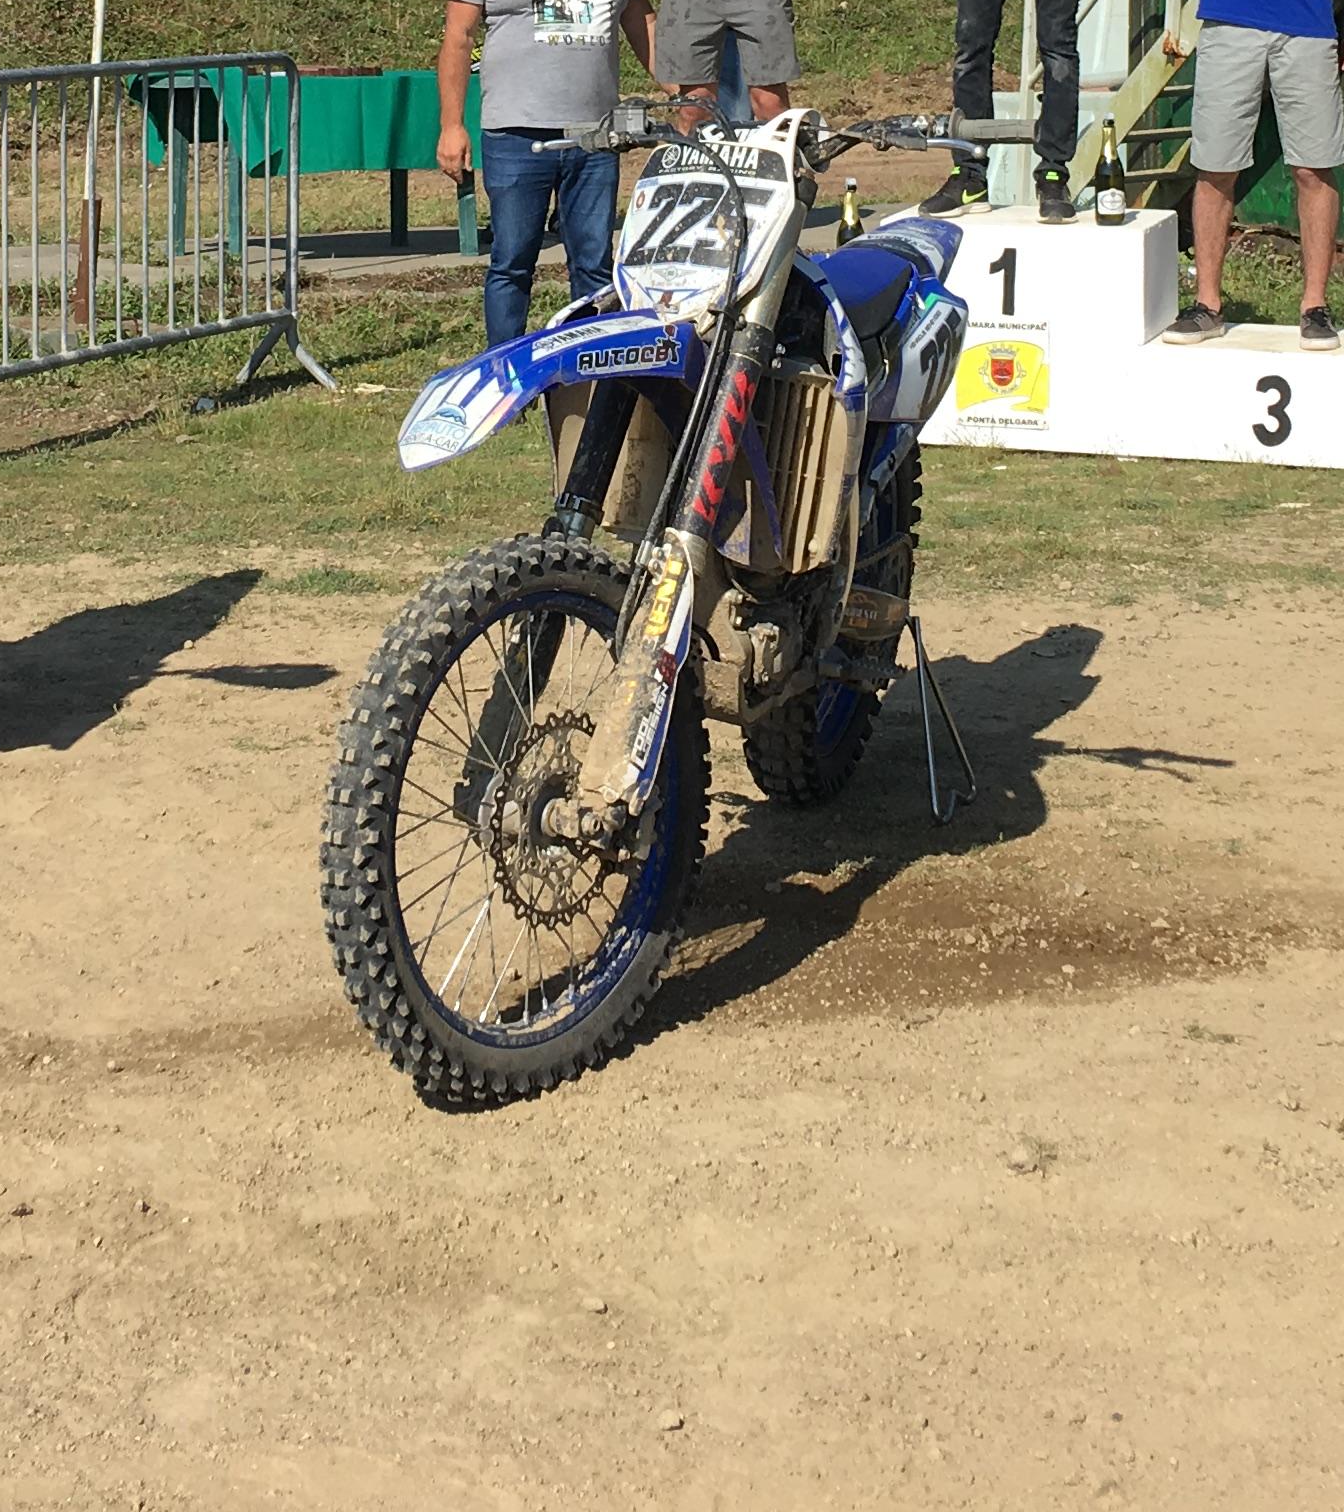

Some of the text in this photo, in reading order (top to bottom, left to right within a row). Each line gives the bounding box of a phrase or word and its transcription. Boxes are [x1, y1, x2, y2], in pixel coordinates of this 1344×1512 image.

[989, 248, 1016, 316] 1
[552, 326, 608, 348] YAMAHA
[998, 322, 1047, 330] MUNICIPAL
[967, 416, 1039, 426] PONTA DELGADA
[1251, 373, 1292, 448] 3
